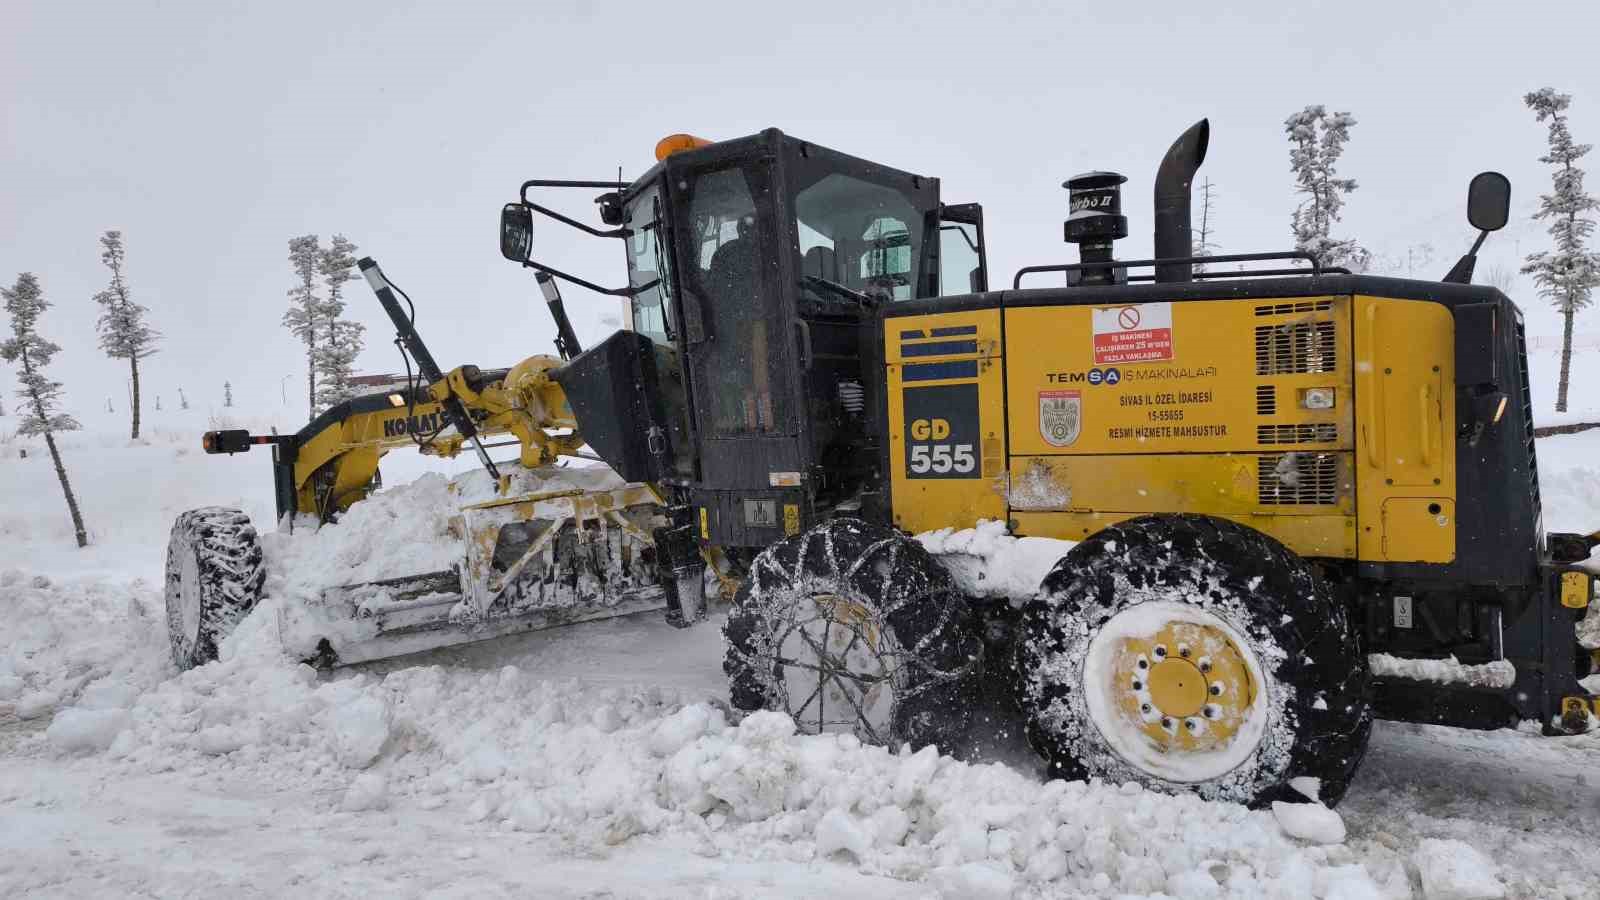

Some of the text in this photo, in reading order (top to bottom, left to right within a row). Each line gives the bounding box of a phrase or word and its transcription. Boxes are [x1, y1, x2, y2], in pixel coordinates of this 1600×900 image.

[1047, 368, 1120, 385] TEMSA
[912, 419, 950, 440] GD
[1173, 425, 1227, 438] MAHSUSTUR
[911, 444, 976, 473] 555
